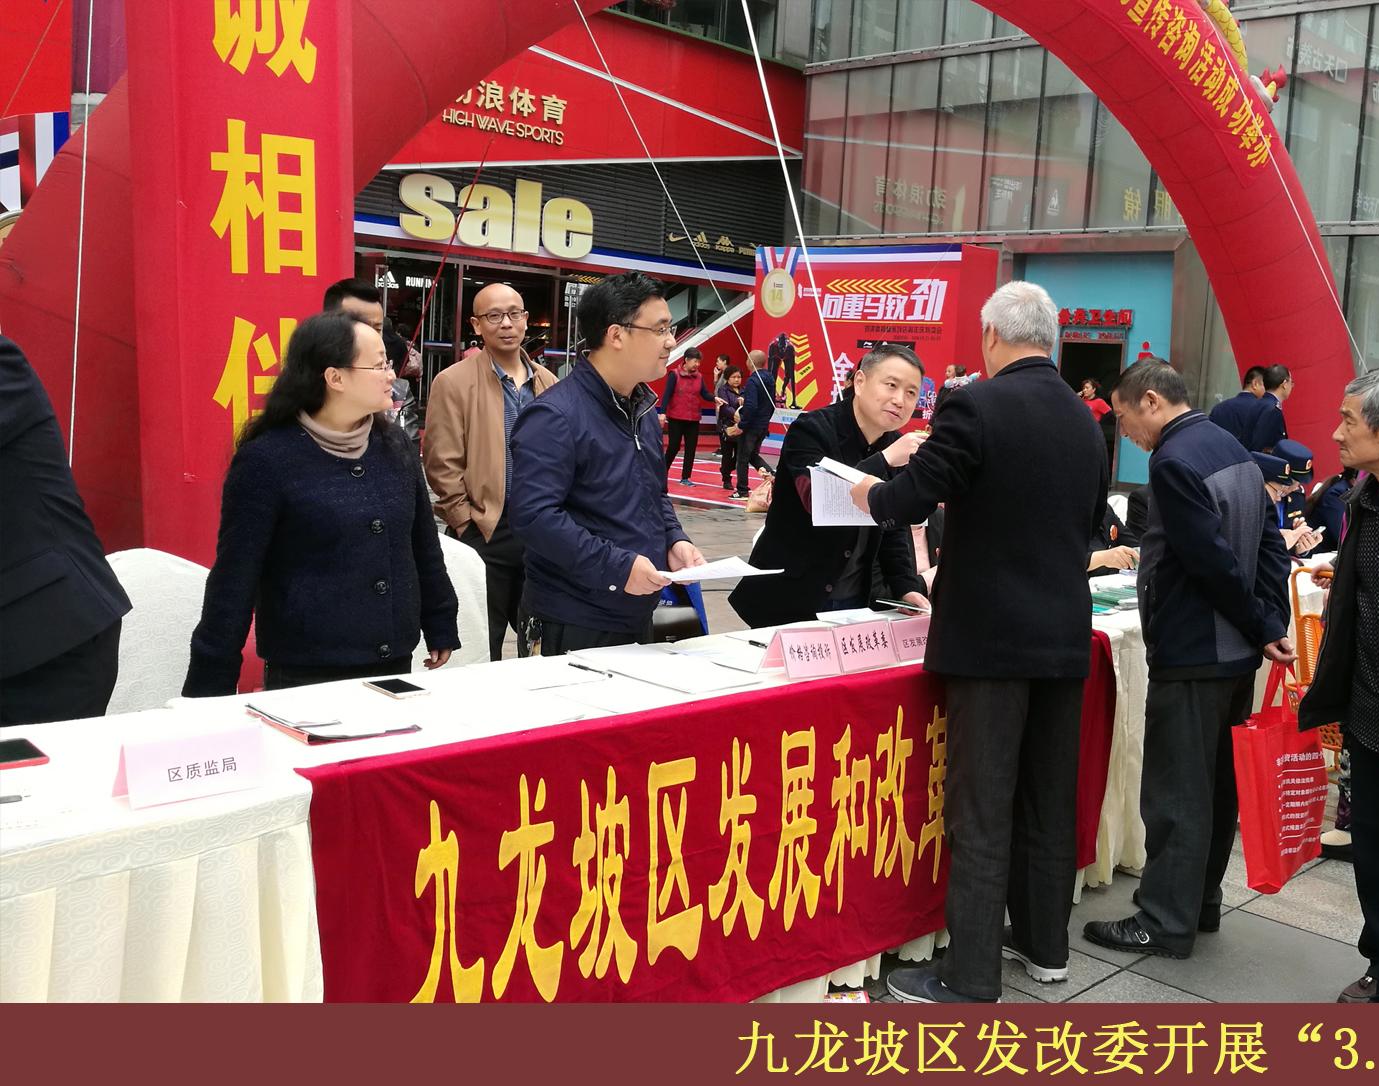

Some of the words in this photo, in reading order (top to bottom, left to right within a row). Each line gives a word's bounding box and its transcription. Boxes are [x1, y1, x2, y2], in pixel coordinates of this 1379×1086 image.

[1121, 0, 1272, 168] 宣传咨询活动成功举办
[442, 108, 474, 129] HIGH
[476, 115, 515, 137] WAVE
[515, 122, 565, 146] SPORTS
[399, 173, 594, 260] sale
[789, 643, 831, 662] 价格咨询投诉
[842, 630, 889, 656] 区发展改革委
[167, 756, 238, 783] 区质监局
